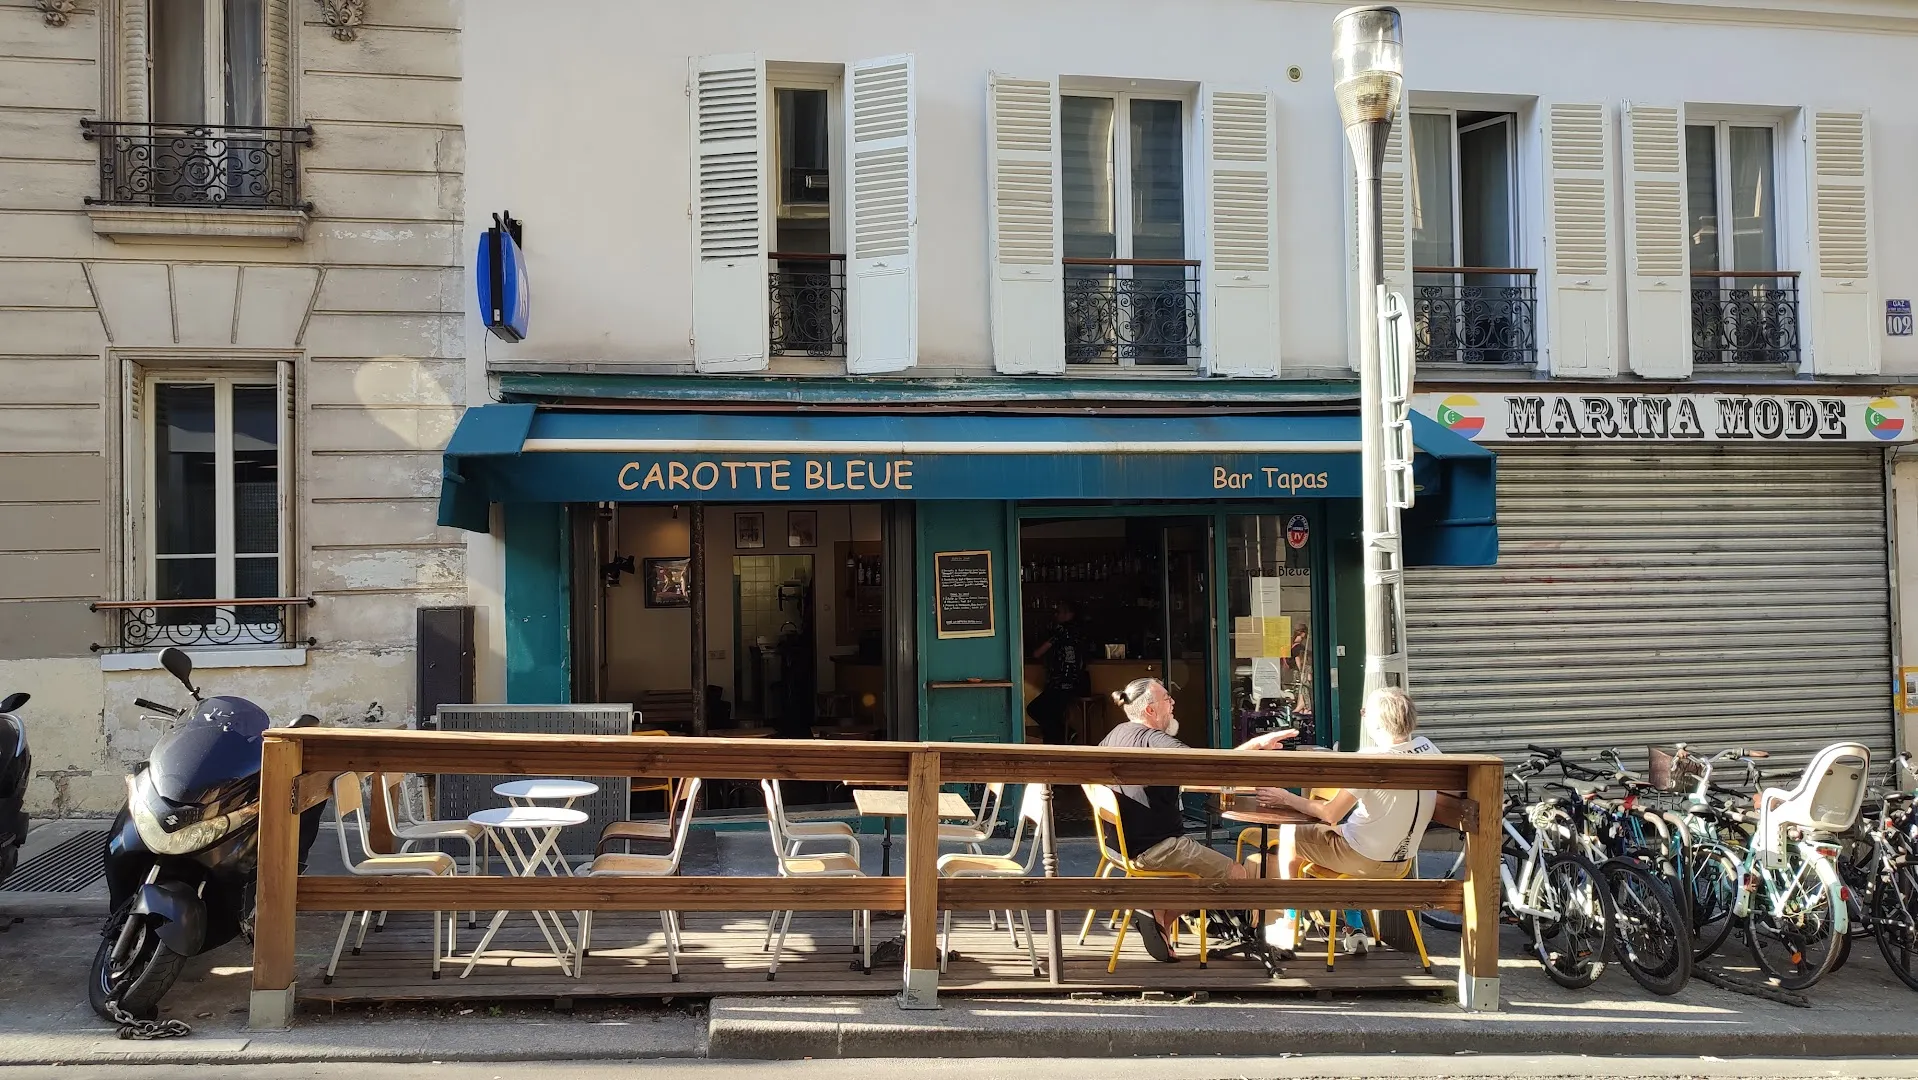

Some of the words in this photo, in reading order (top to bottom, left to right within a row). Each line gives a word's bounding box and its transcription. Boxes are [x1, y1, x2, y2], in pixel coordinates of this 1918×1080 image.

[1887, 315, 1912, 335] 102
[1504, 396, 1704, 439] MARINA
[1714, 397, 1847, 440] MODE
[617, 460, 791, 491] CAROTTE
[804, 460, 913, 491] BLEUE
[1213, 466, 1253, 489] Bar
[1261, 467, 1328, 495] Tapas
[1293, 532, 1303, 540] IV
[1278, 565, 1310, 577] Bleue
